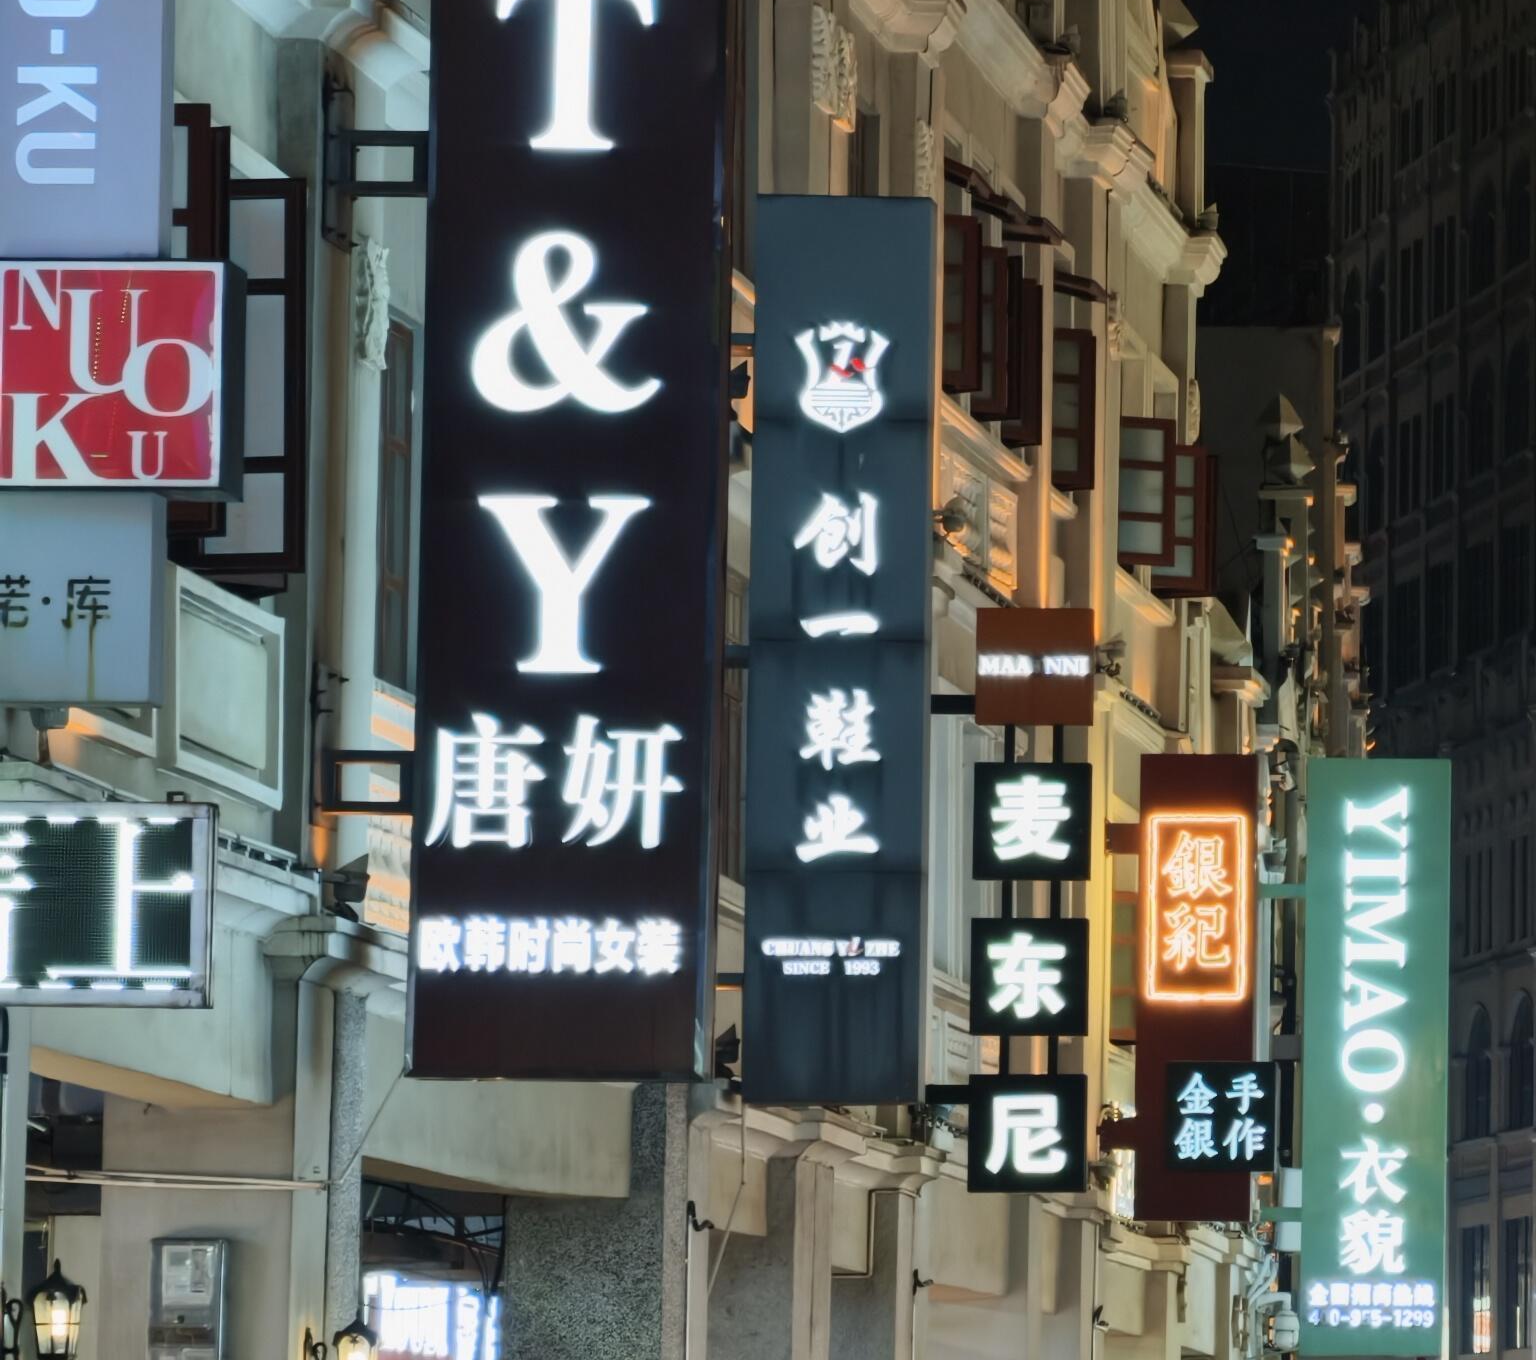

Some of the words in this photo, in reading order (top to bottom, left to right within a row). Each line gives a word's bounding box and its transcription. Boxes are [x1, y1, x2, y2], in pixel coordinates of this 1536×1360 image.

[793, 490, 882, 864] 创一鞋业
[424, 711, 684, 850] 唐妍
[417, 914, 684, 977] 欧韩时尚女装
[782, 960, 831, 975] SINCE
[844, 960, 881, 975] 1993
[978, 773, 1074, 1176] 麦东尼
